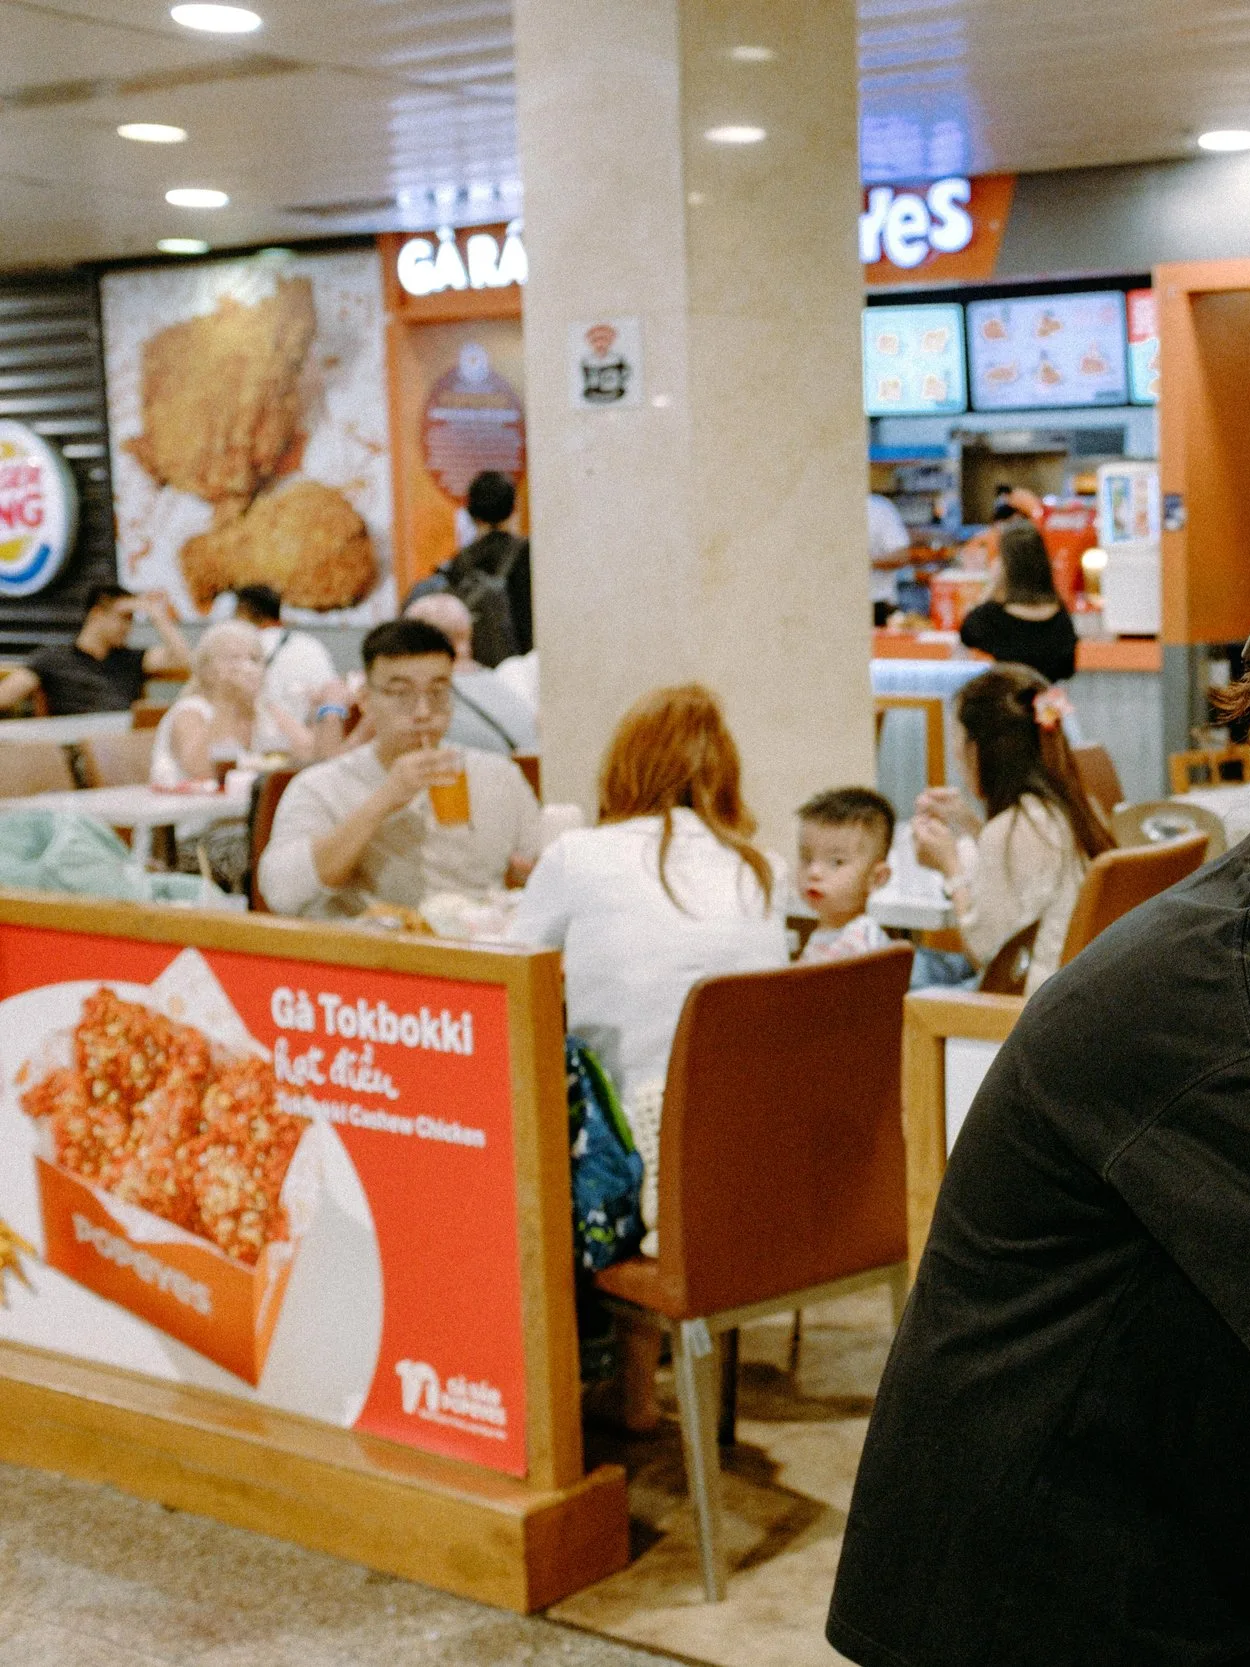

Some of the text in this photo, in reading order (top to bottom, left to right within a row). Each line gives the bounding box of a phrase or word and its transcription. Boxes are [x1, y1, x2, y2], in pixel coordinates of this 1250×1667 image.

[271, 986, 474, 1056] Gà Tokbokki
[415, 1114, 487, 1149] Chicken
